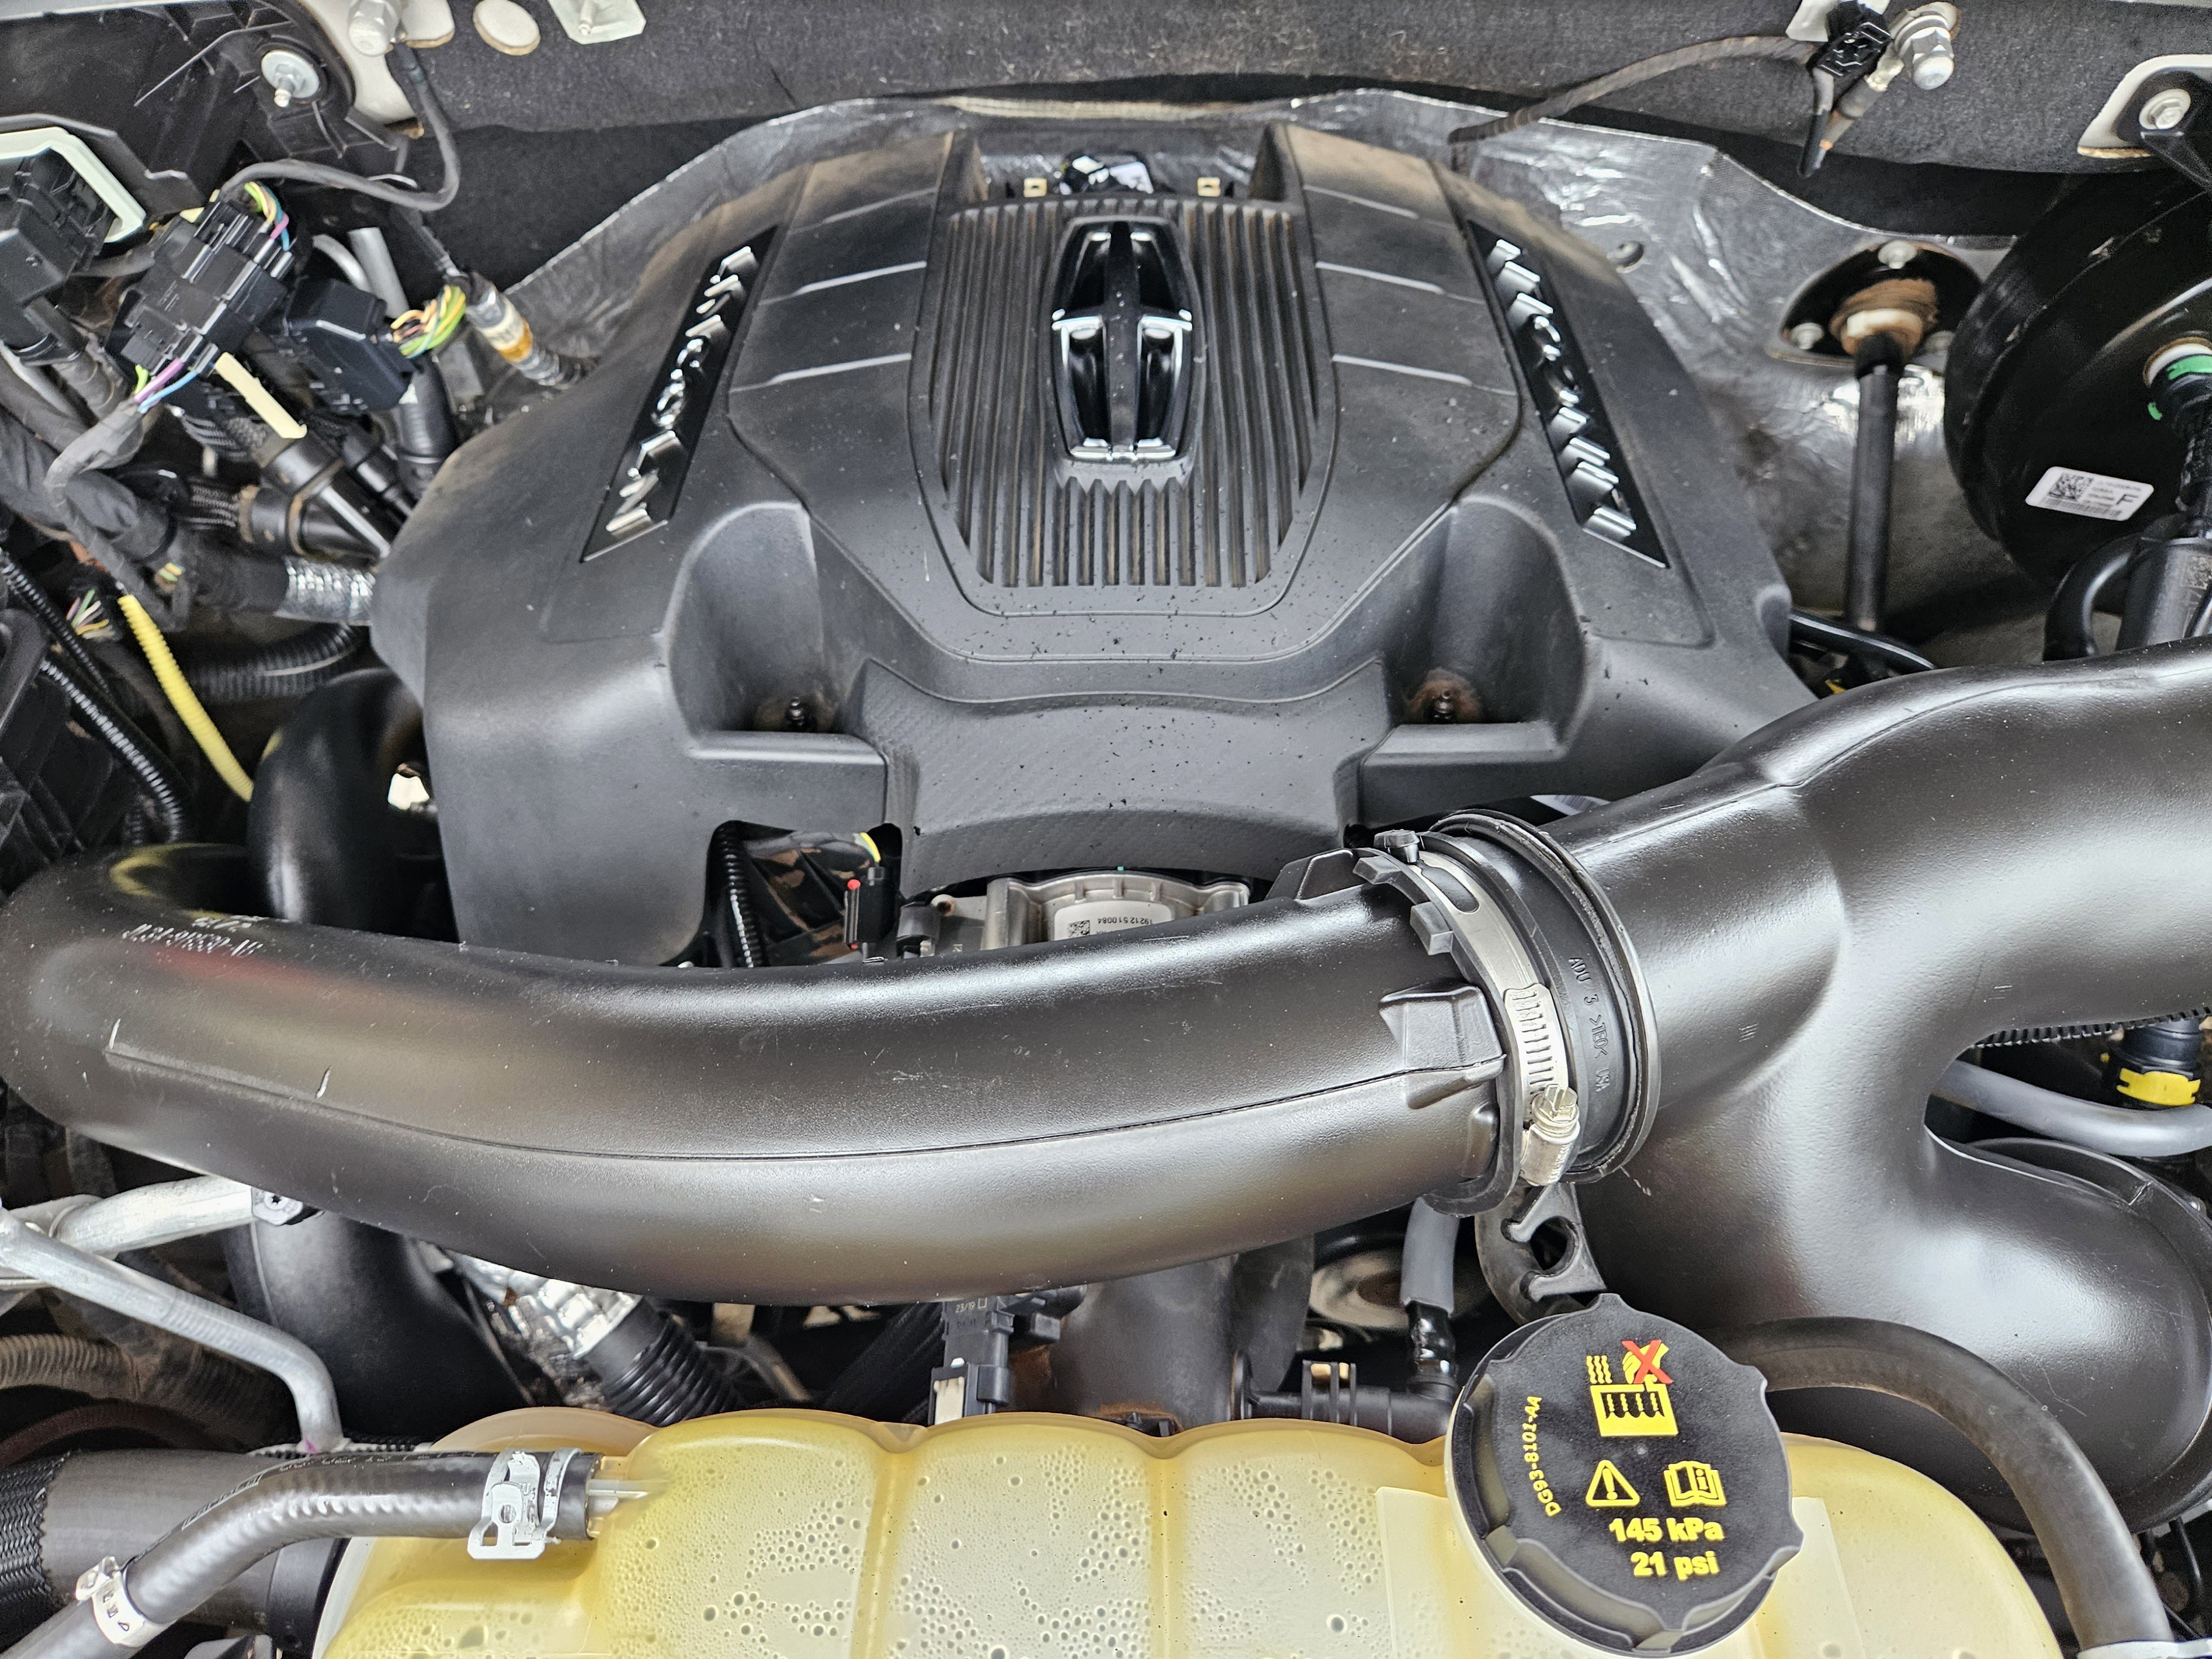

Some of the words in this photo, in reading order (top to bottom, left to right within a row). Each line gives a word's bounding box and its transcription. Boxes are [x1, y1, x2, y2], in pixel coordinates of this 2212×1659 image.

[2116, 494, 2140, 505] F
[1568, 957, 1592, 983] ADU
[1583, 994, 1599, 1006] 3
[1595, 1066, 1611, 1093] USA
[1521, 1395, 1562, 1517] DG93-8101-AA
[1609, 1517, 1663, 1542] 145
[1666, 1517, 1725, 1542] kPa
[1630, 1551, 1667, 1577] 21
[1673, 1550, 1721, 1582] psi
